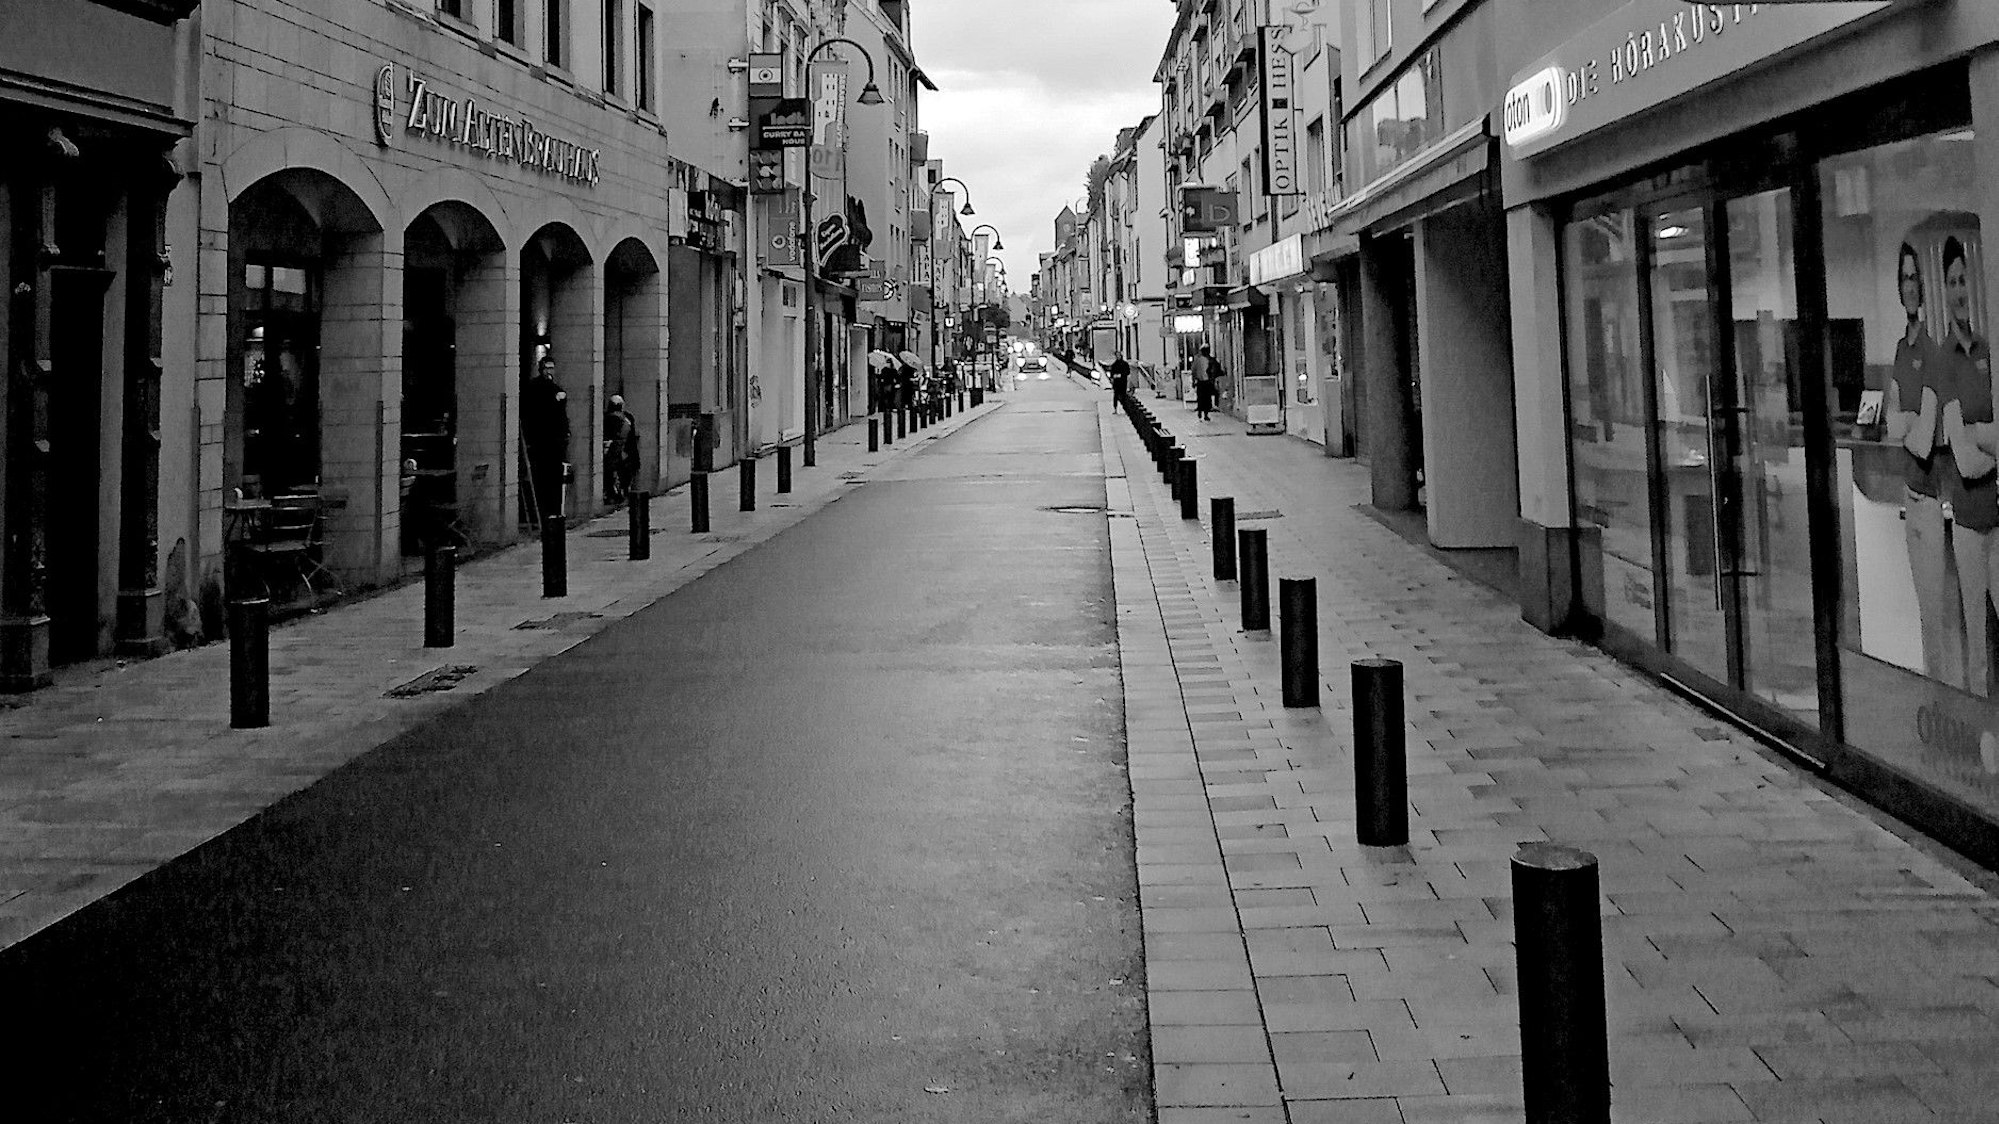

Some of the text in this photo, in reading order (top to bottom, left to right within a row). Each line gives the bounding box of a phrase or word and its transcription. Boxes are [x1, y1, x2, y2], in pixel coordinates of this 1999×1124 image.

[1567, 3, 1758, 105] DIE HÖRAKUS
[407, 69, 461, 142] ZUM
[1271, 28, 1290, 190] OPTIK HESS
[1506, 92, 1531, 132] oton
[787, 221, 796, 262] vodafone
